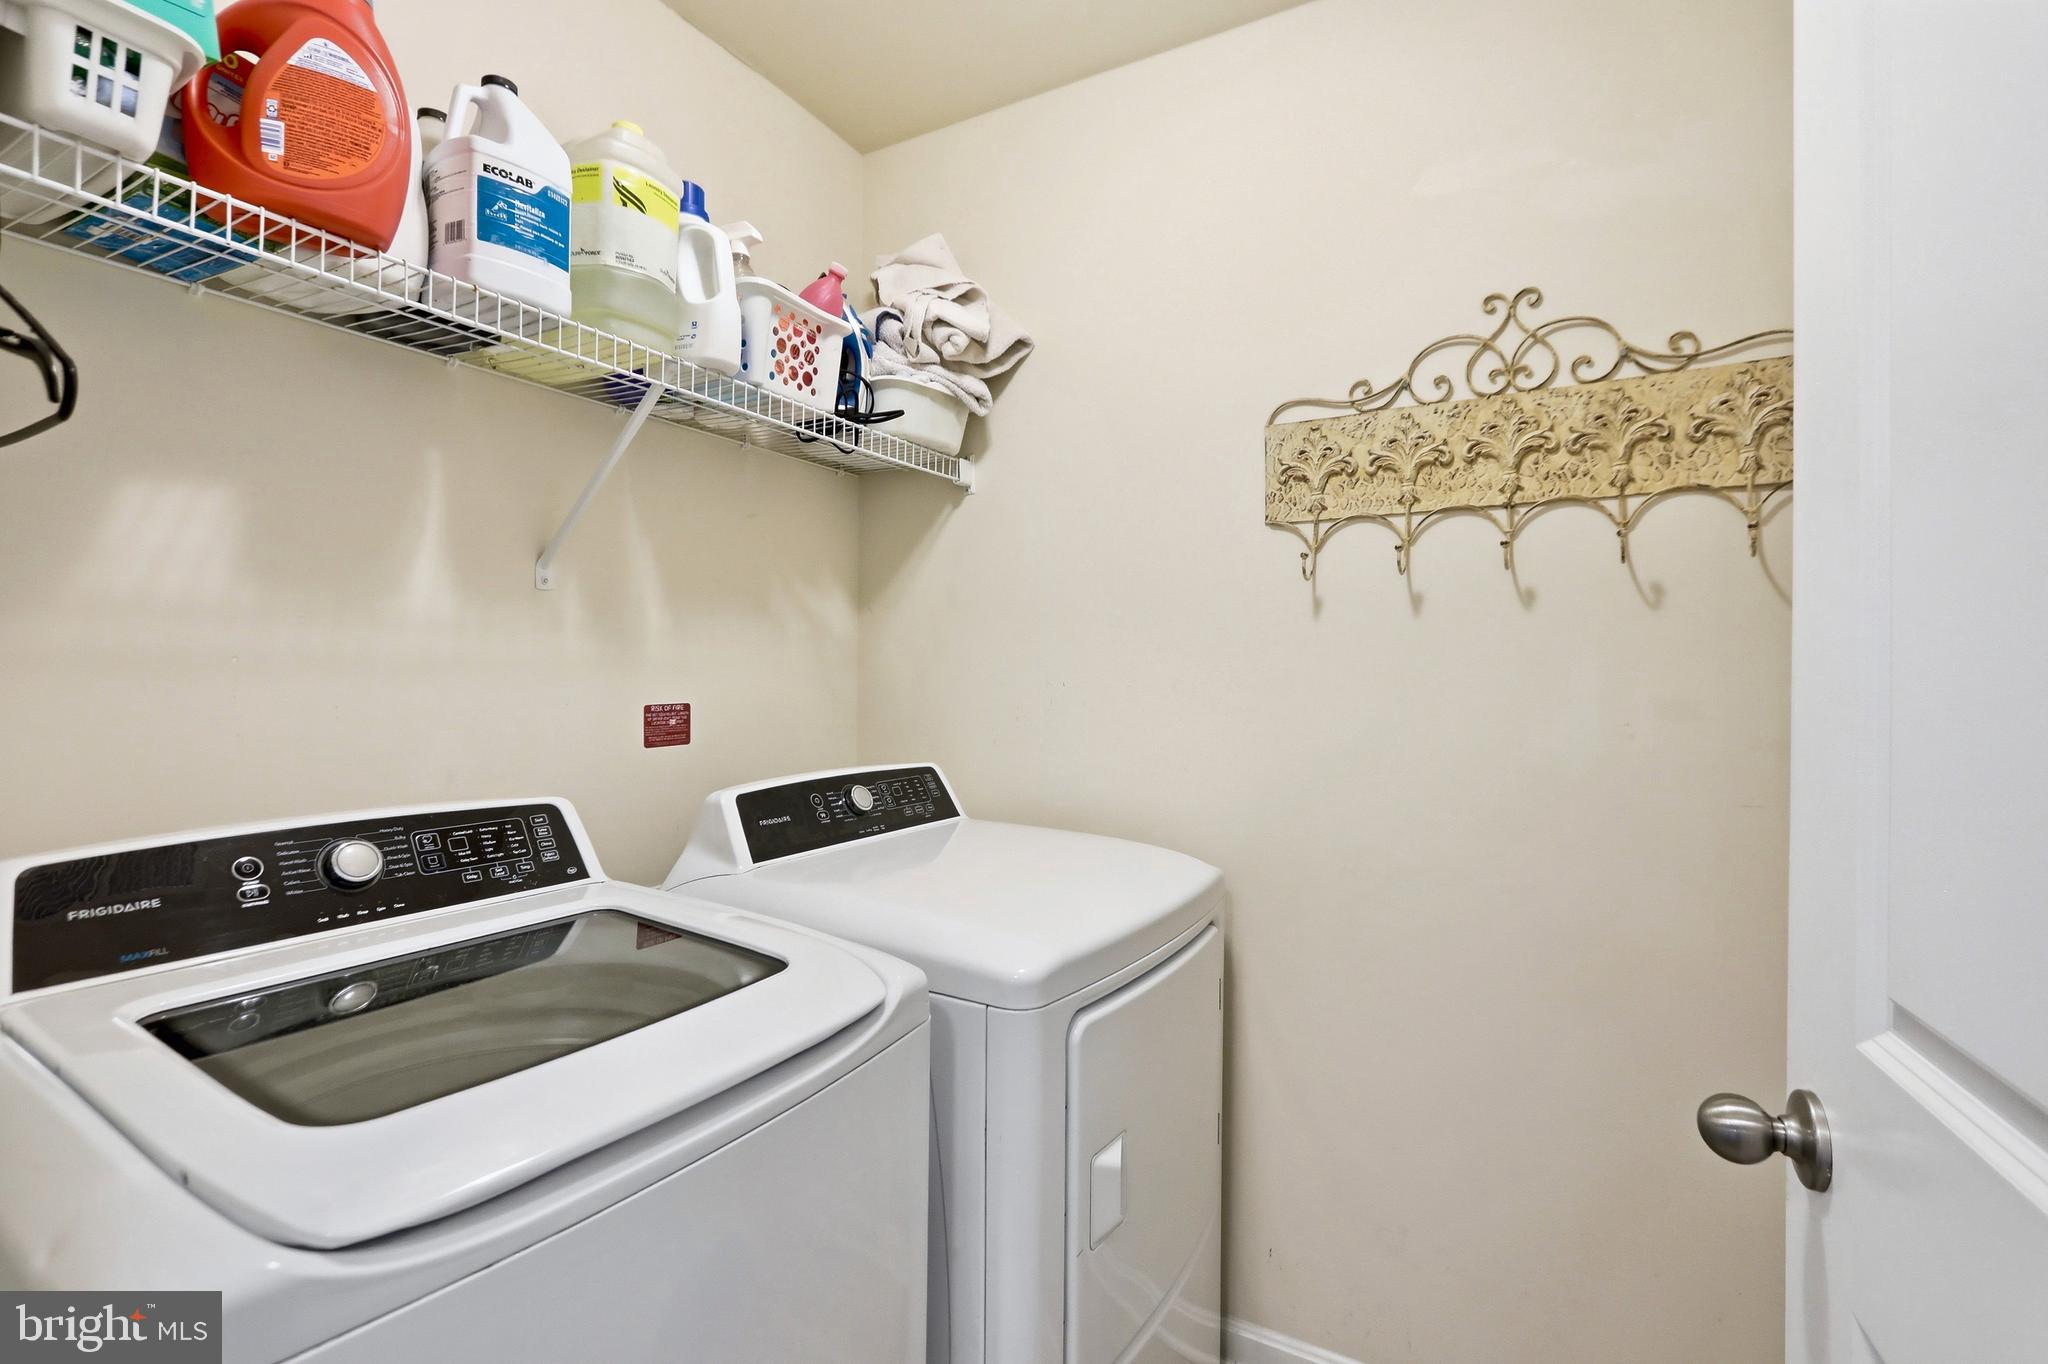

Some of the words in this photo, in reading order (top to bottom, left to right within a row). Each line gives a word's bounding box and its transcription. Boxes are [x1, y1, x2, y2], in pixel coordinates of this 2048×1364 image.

[482, 163, 534, 189] ECOLAB
[759, 815, 792, 826] FRIGIDAIRE
[67, 897, 162, 921] FRIGIDAIRE
